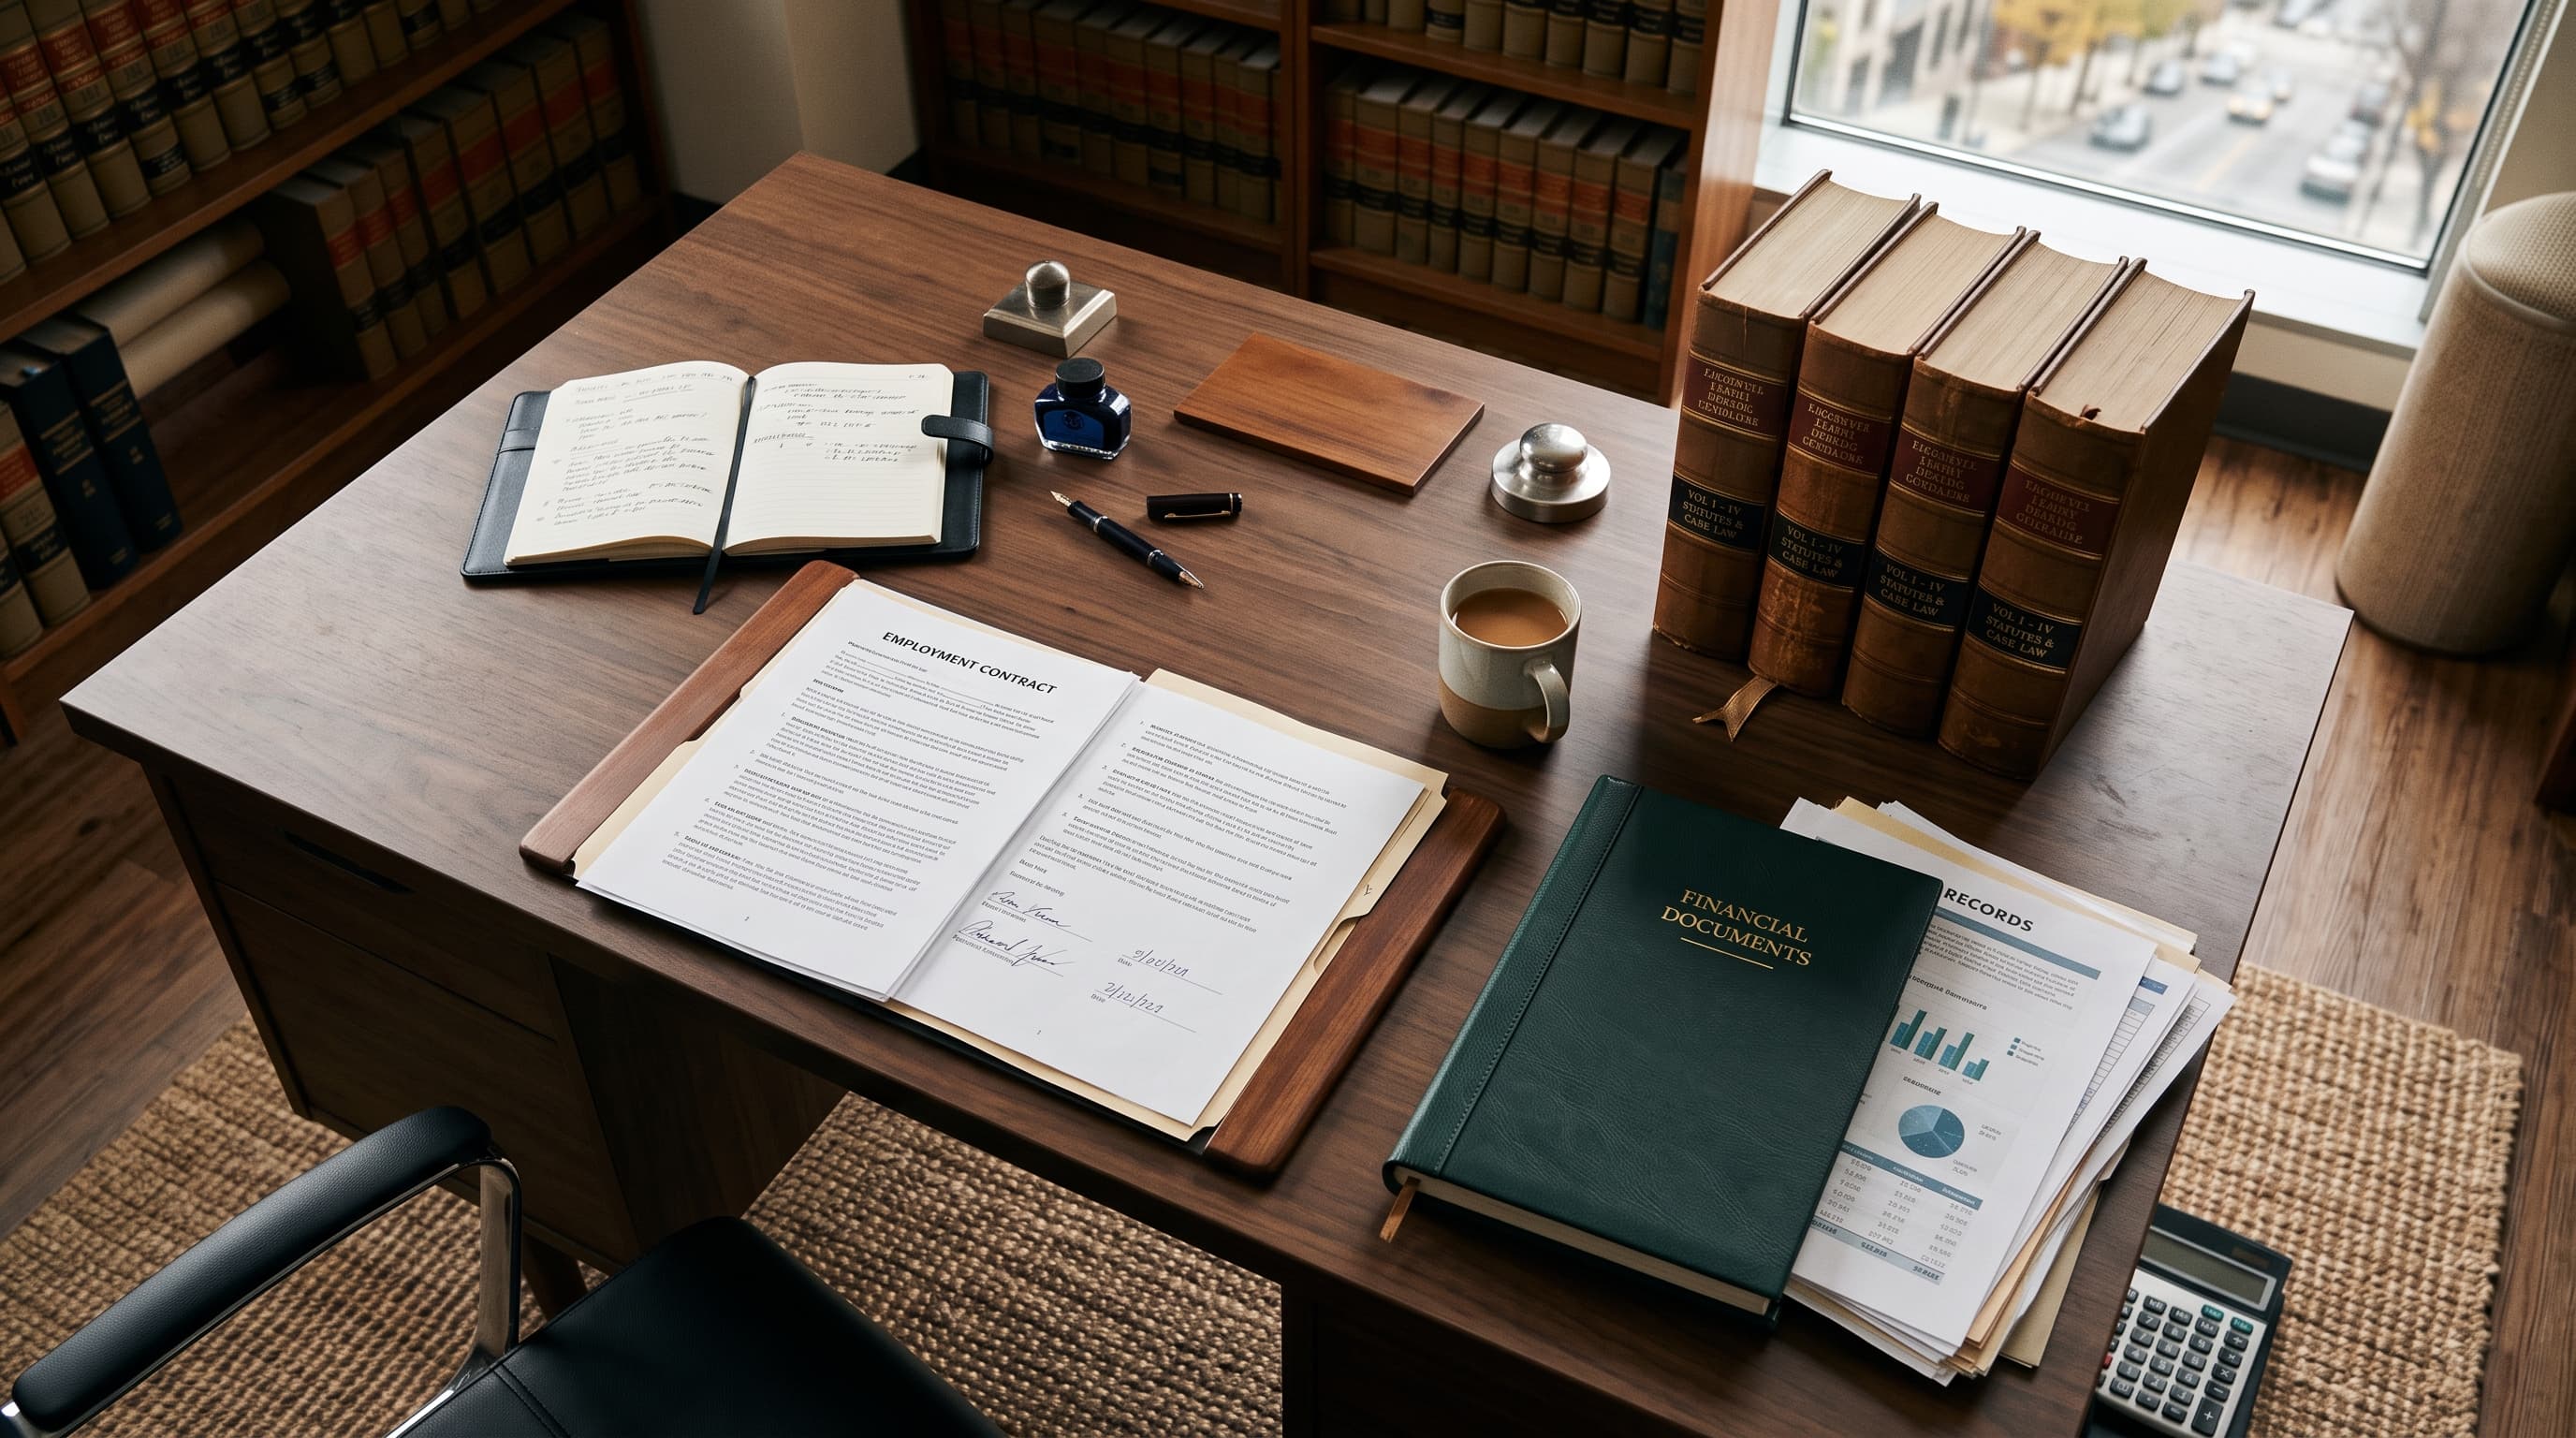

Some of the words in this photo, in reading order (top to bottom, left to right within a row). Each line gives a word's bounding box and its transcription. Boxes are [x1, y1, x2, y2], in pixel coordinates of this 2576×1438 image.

[1688, 489, 1707, 506] VOL
[1714, 525, 1737, 539] LAW
[1787, 525, 1808, 543] VOL
[1812, 564, 1838, 578] LAW
[1886, 564, 1908, 581] VOL
[1912, 602, 1939, 616] LAW
[1993, 603, 2014, 622] VOL
[1985, 615, 2042, 644] STATUTES
[1986, 629, 2016, 648] CASE
[2020, 643, 2047, 658] LAW
[882, 631, 979, 670] EMPLOYMENT
[979, 665, 1058, 695] CONTRACT
[1680, 889, 1808, 943] FINANCIAL
[1944, 888, 2034, 932] RECORDS
[1661, 905, 1812, 966] DOCUMENTS
